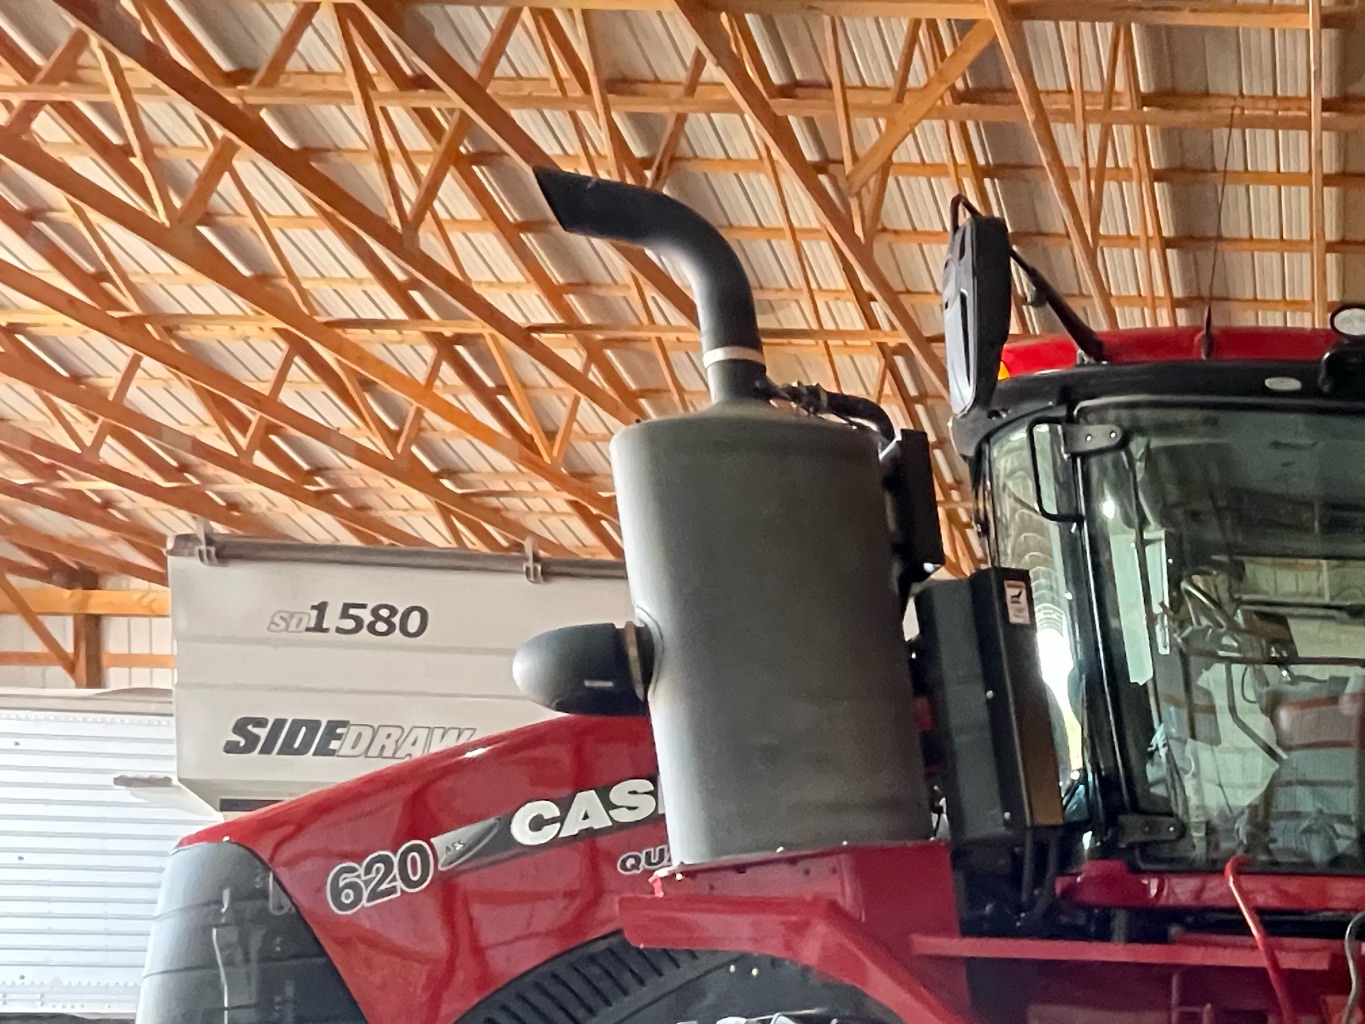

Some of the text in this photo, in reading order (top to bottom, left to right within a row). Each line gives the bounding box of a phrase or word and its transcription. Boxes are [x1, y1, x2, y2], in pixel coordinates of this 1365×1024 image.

[510, 779, 666, 846] CAS
[326, 839, 434, 915] 620
[617, 844, 673, 875] QU
